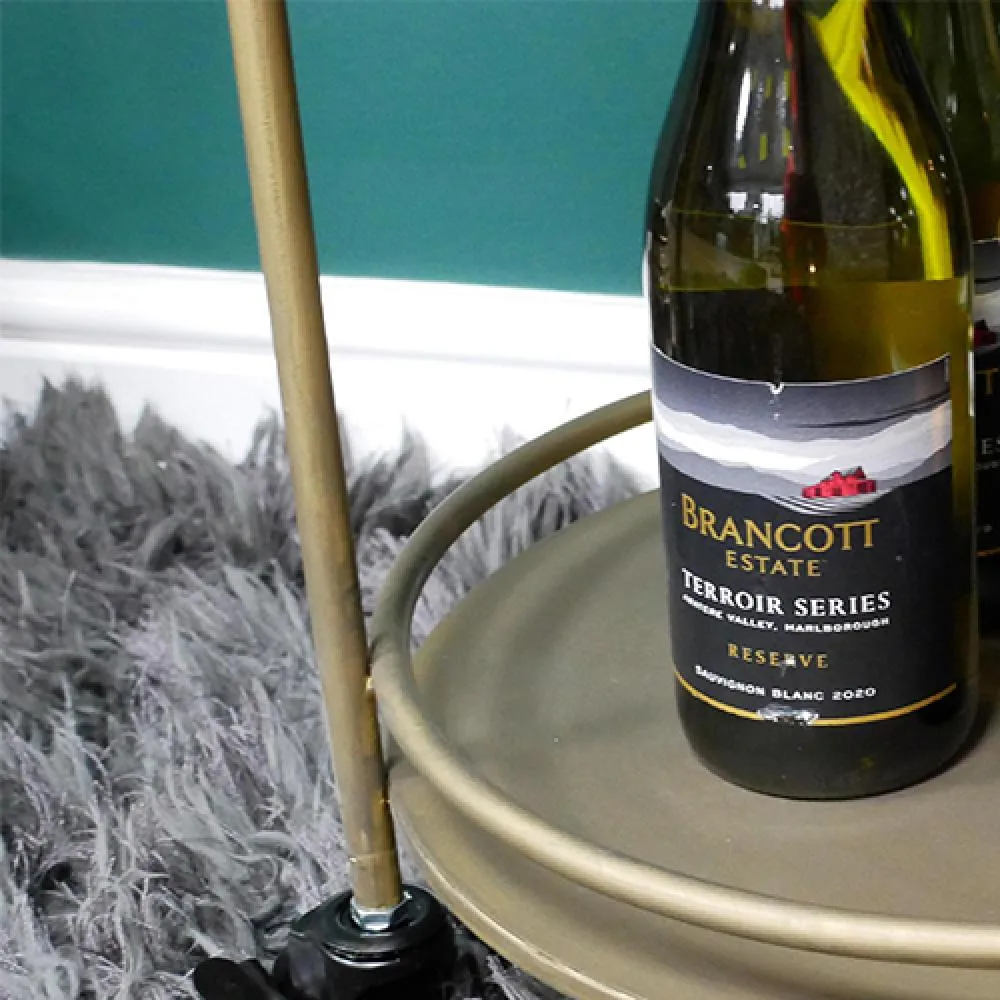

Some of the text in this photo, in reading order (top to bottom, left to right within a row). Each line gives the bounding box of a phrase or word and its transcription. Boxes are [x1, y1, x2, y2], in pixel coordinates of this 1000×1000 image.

[681, 493, 880, 552] BRANCOTT
[725, 550, 821, 577] ESTATE
[682, 568, 890, 617] TERROIR SERIES
[728, 643, 829, 669] RESERVE
[771, 687, 825, 701] BLANC
[831, 687, 877, 700] 2020
